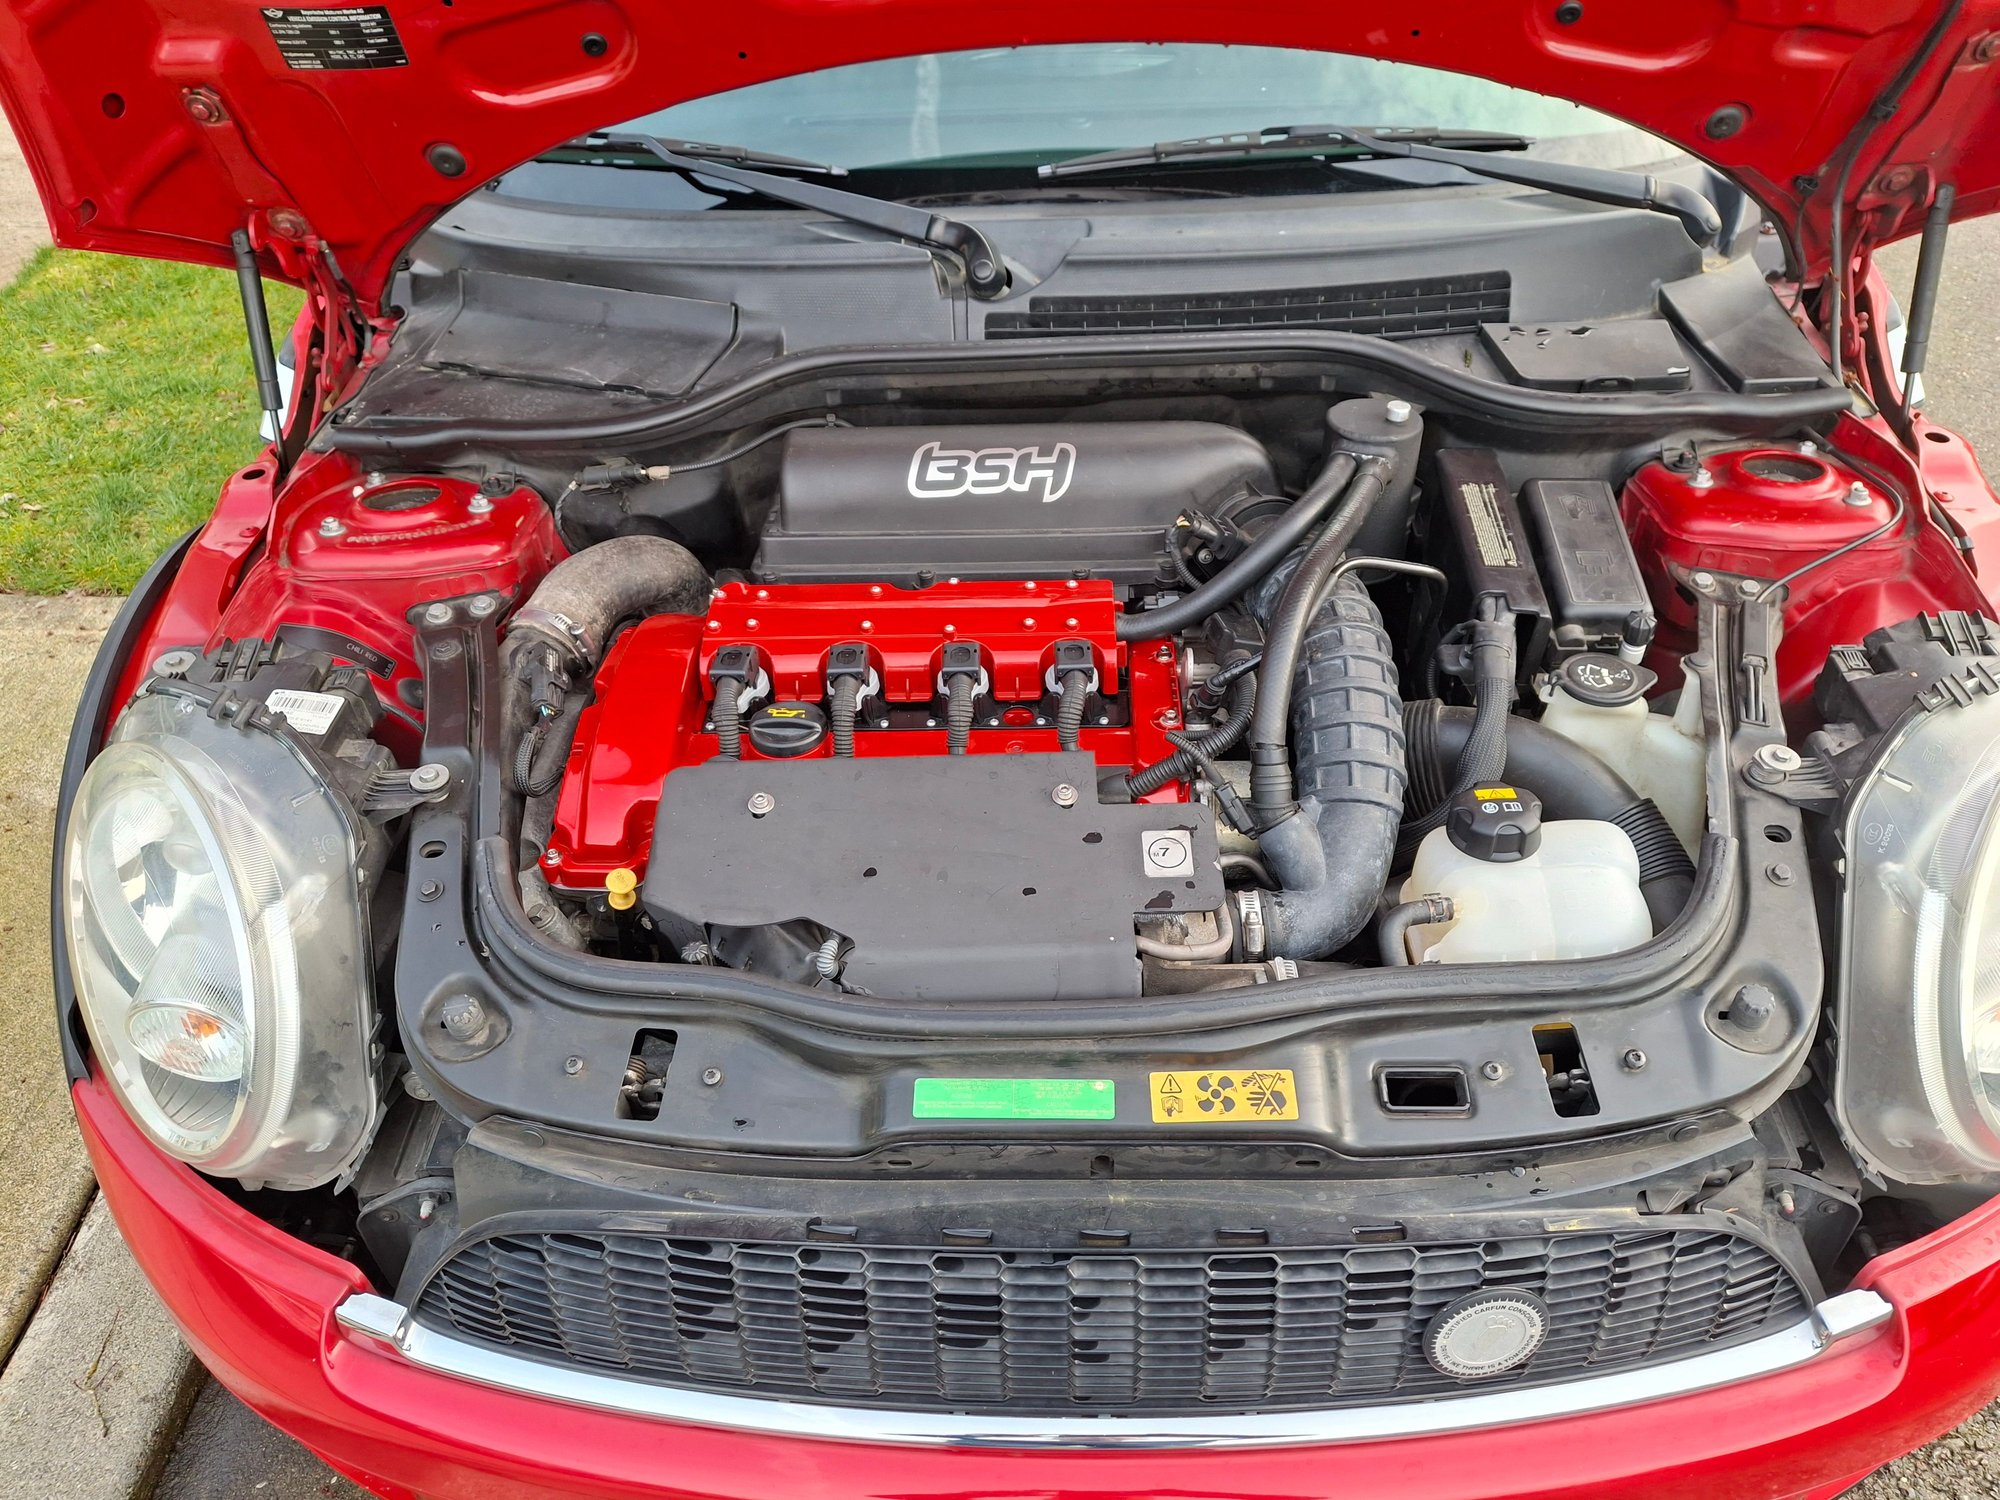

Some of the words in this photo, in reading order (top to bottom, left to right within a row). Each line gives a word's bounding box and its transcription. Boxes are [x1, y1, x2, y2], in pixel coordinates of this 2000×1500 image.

[907, 441, 1077, 503] BSH
[346, 643, 364, 654] CHILI
[364, 651, 378, 662] RED
[1443, 1313, 1473, 1340] CERTIFIED
[1474, 1305, 1507, 1315] CARFUN
[1508, 1305, 1537, 1328] CONSCIOUS
[1440, 1344, 1450, 1360] DRIVE
[1447, 1359, 1462, 1368] LIKE
[1505, 1335, 1535, 1362] TOMORROW
